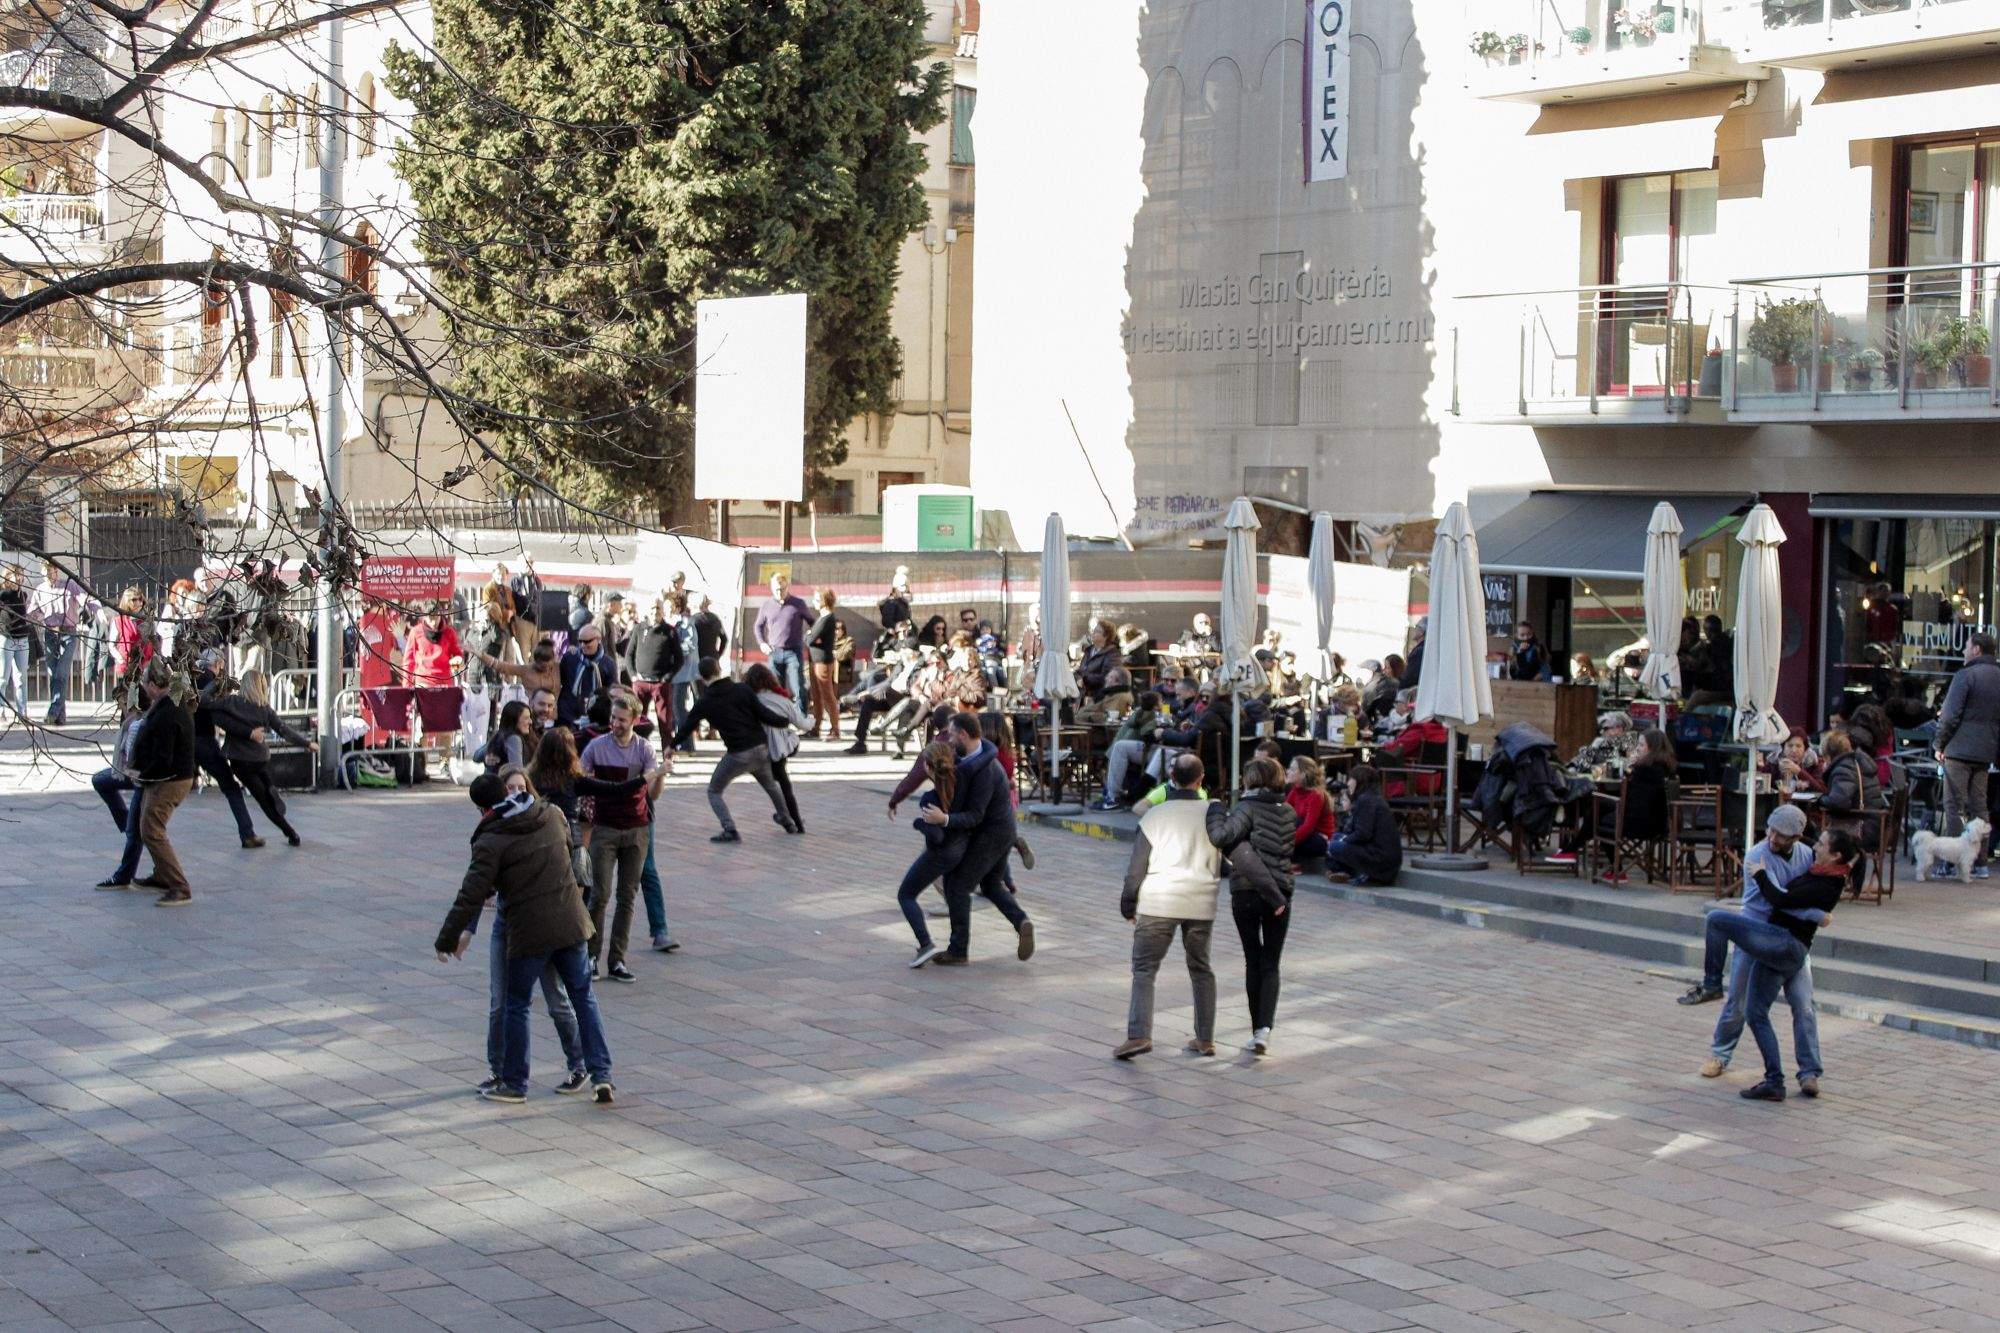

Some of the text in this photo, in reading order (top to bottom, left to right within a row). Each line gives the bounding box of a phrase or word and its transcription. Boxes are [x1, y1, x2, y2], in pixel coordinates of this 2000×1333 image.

[1320, 1, 1343, 163] OTEX
[1248, 273, 1290, 305] Can
[1142, 321, 1224, 354] destinat
[1229, 328, 1240, 350] a
[1247, 313, 1391, 357] equipament
[366, 565, 403, 576] SWING
[416, 566, 451, 576] carrer
